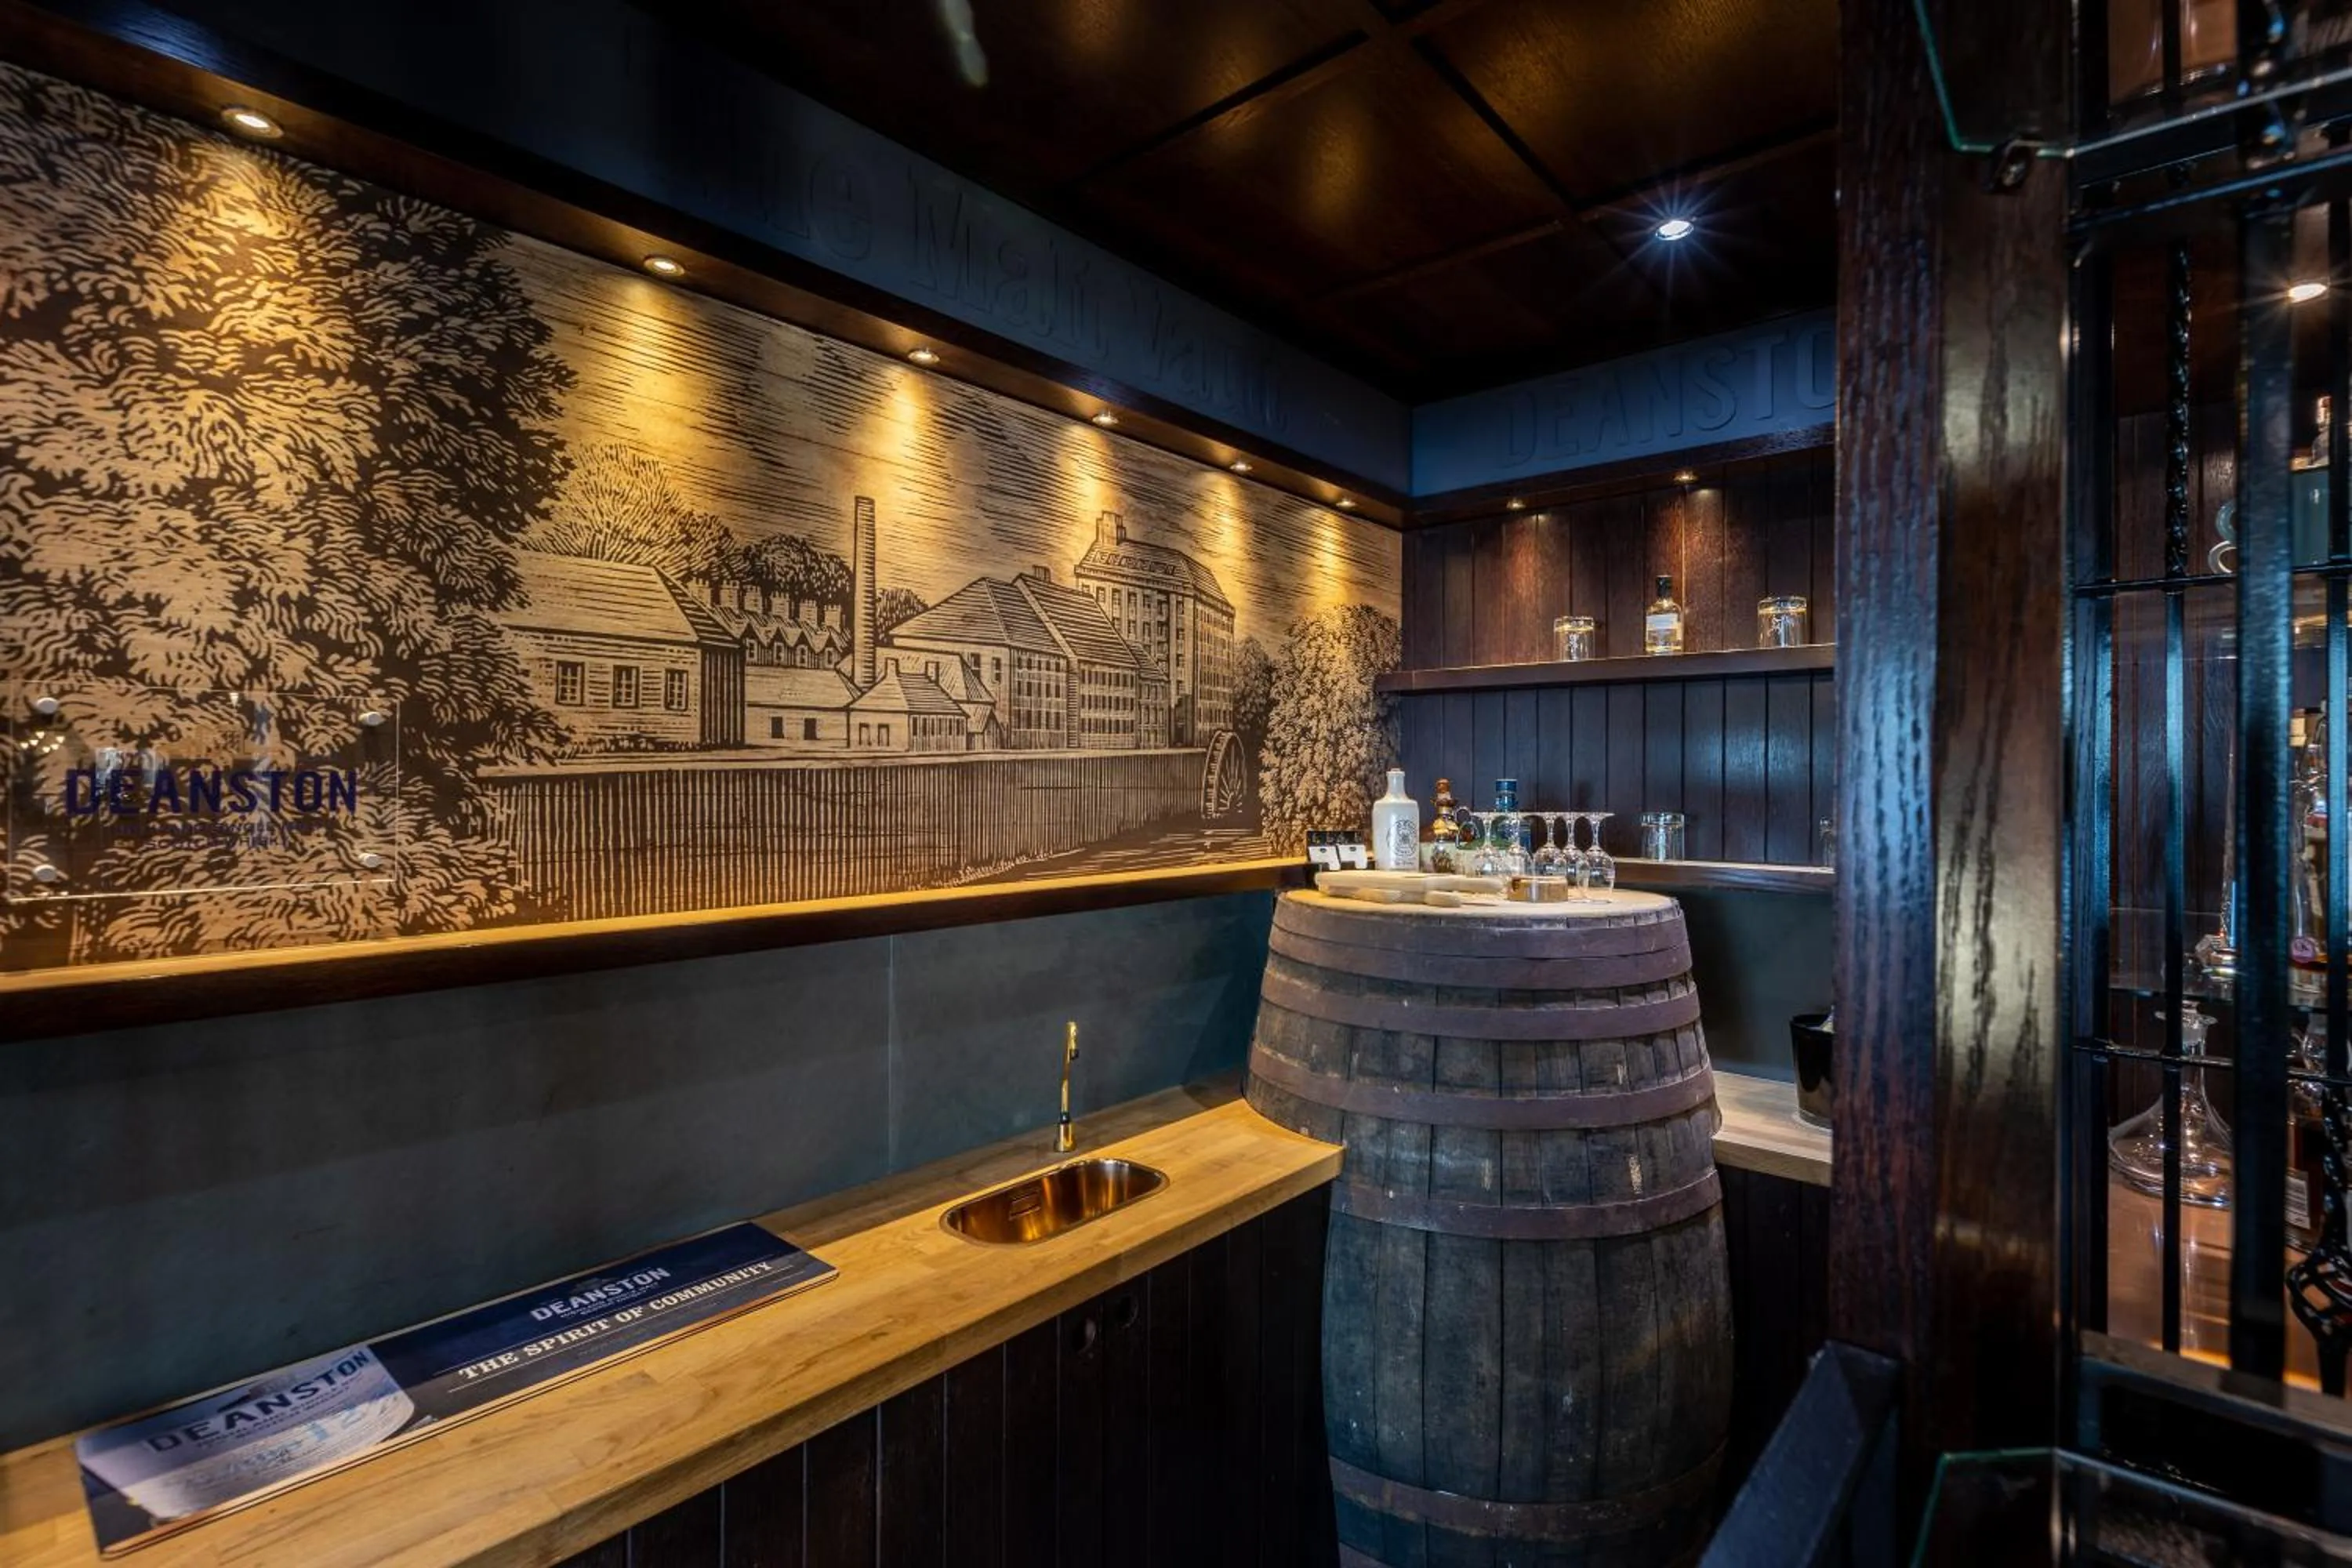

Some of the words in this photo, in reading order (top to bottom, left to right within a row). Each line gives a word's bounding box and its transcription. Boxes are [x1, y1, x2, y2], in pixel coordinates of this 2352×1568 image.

[904, 159, 1111, 362] Malt
[1501, 320, 1836, 469] DEANSTO
[65, 768, 358, 816] DEANSTON
[458, 1350, 521, 1380] THE
[524, 1318, 610, 1357] SPIRIT
[615, 1305, 644, 1323] OF
[648, 1261, 773, 1310] COMMUNITY
[530, 1266, 672, 1322] DEANSTON
[147, 1350, 370, 1453] DEANSTON
